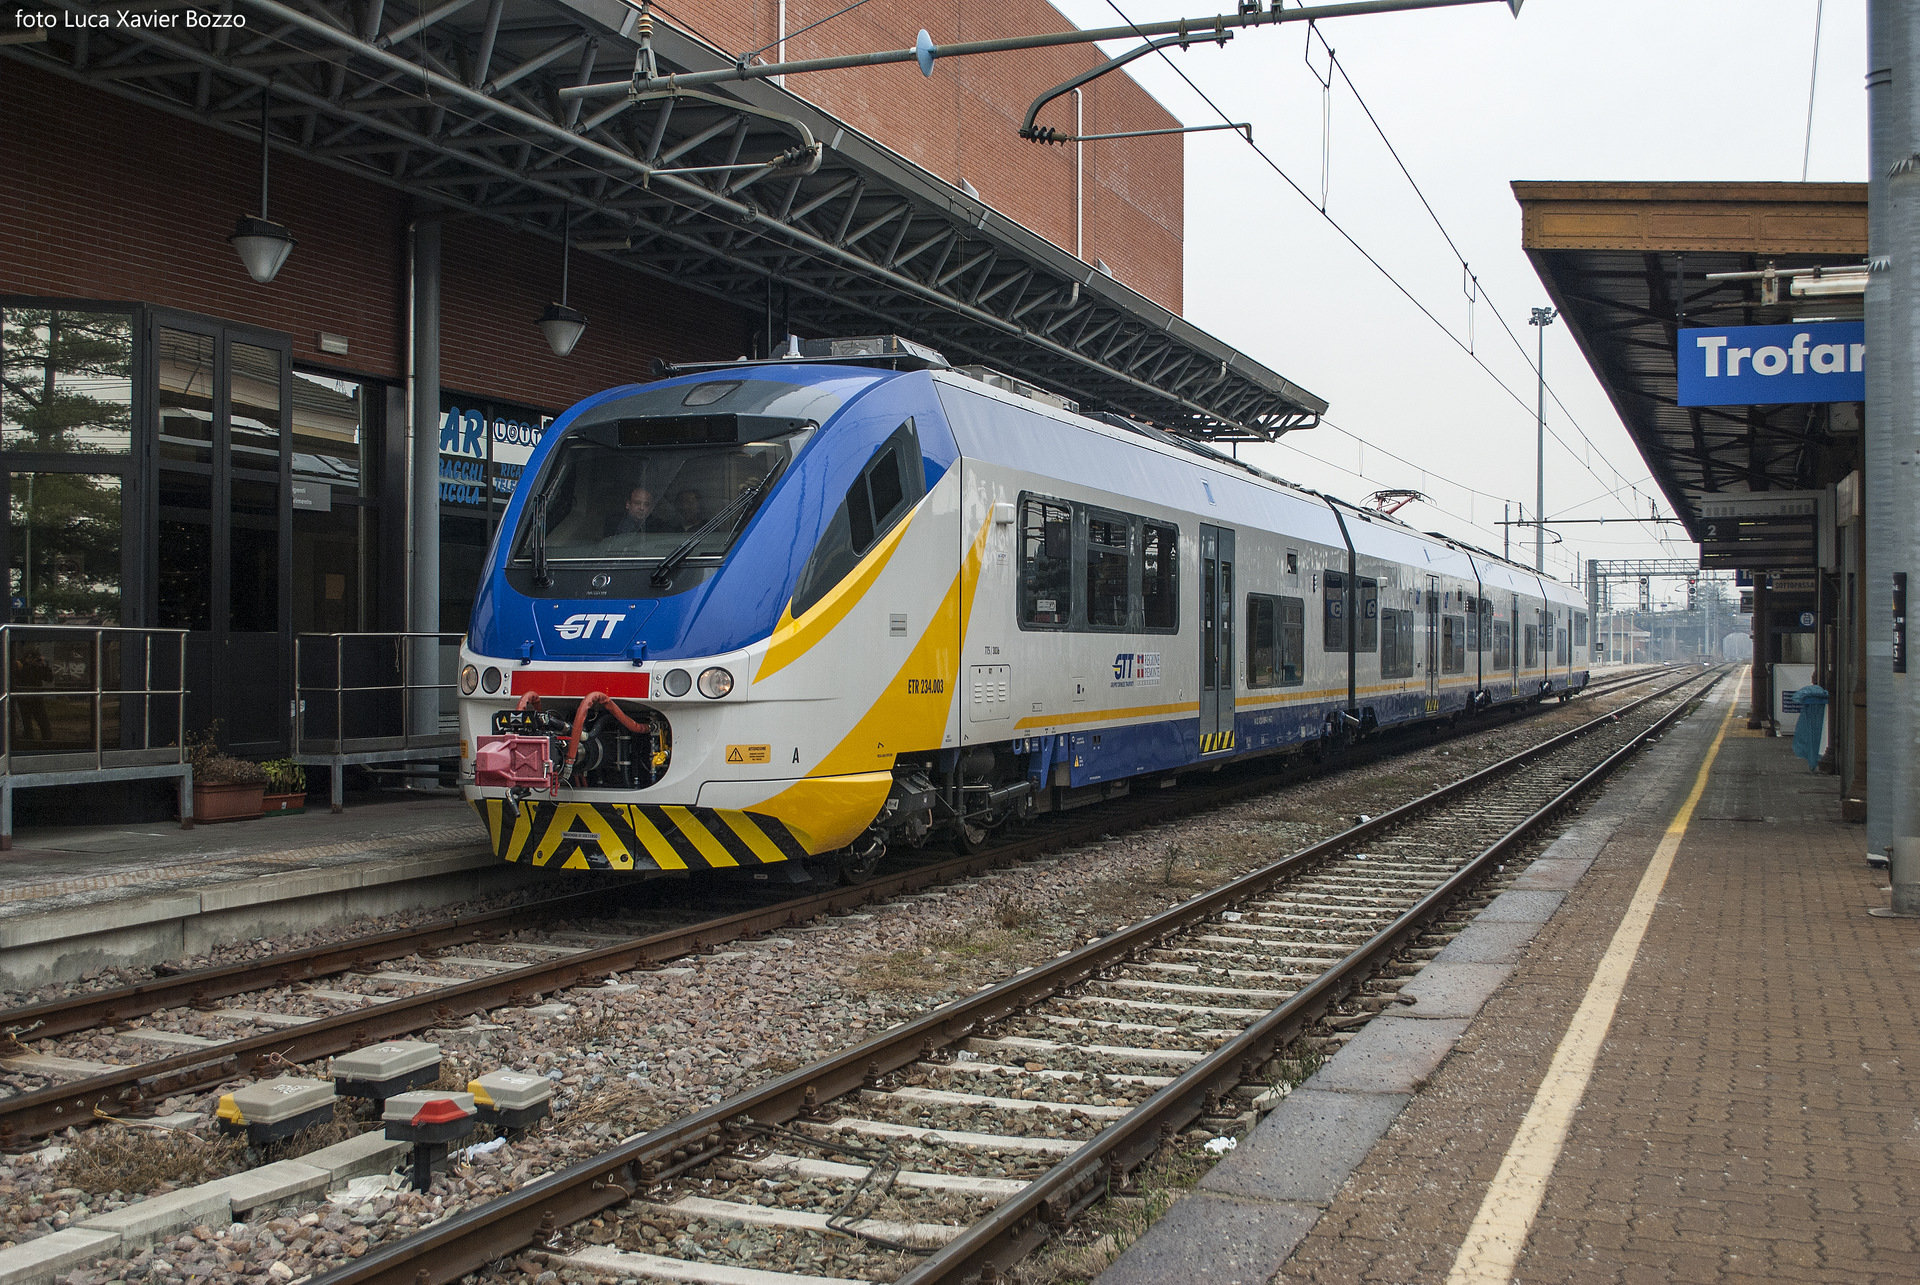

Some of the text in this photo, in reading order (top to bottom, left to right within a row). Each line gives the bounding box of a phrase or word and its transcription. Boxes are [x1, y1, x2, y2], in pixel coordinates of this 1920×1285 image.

[1697, 333, 1866, 377] Trofar
[440, 406, 485, 458] AR
[495, 418, 543, 447] LOTT
[439, 458, 484, 481] BACCHI
[500, 463, 525, 478] RICA
[1707, 524, 1717, 536] 2
[1774, 581, 1815, 590] SOTTOPASSA
[554, 613, 627, 640] GTT
[1111, 653, 1135, 680] GTT
[908, 679, 944, 694] ETR 234.003
[791, 746, 800, 764] A
